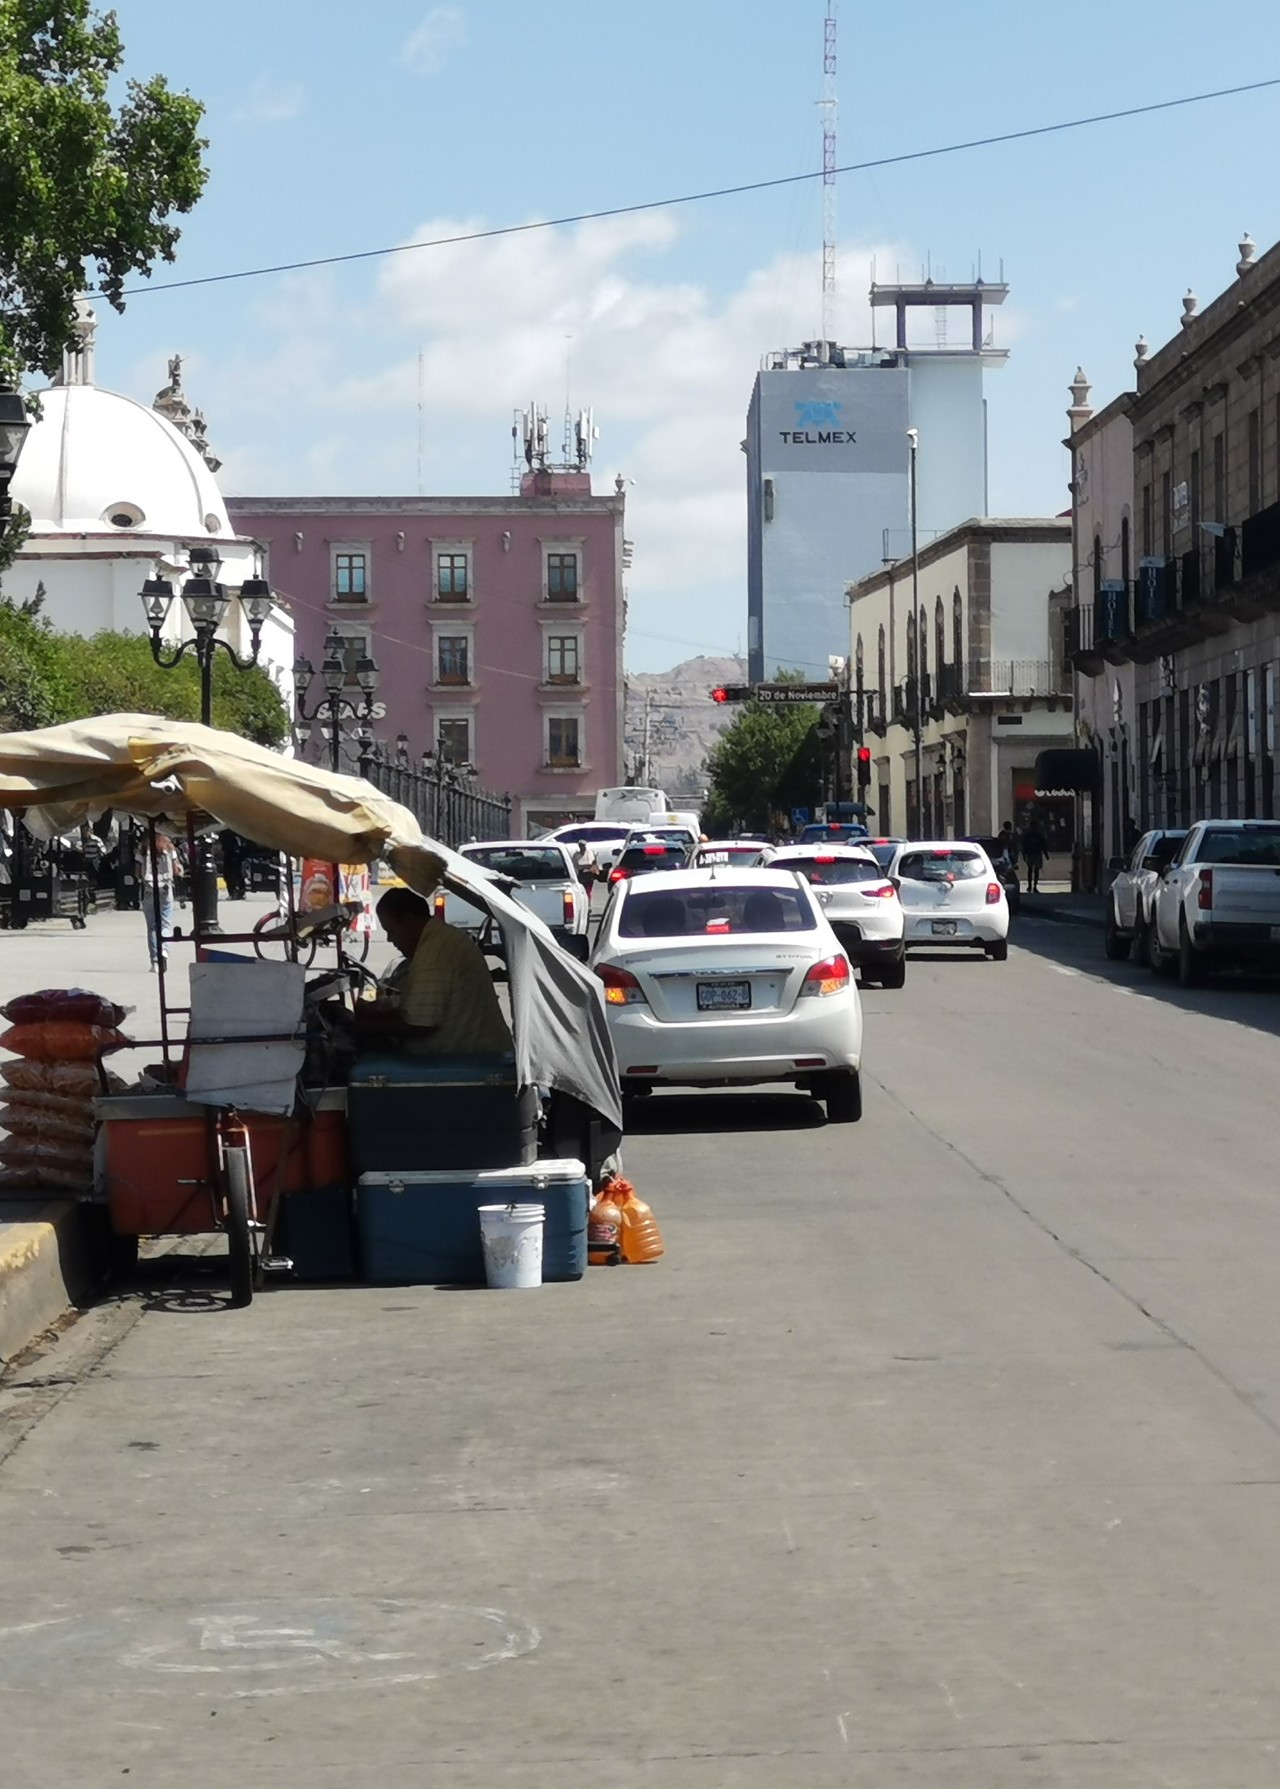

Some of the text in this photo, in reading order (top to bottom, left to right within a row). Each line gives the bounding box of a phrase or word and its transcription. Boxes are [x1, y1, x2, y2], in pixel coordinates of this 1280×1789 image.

[779, 431, 857, 444] TELMEX
[1107, 591, 1117, 639] HOTEL
[759, 690, 837, 701] 20 de Noviembre
